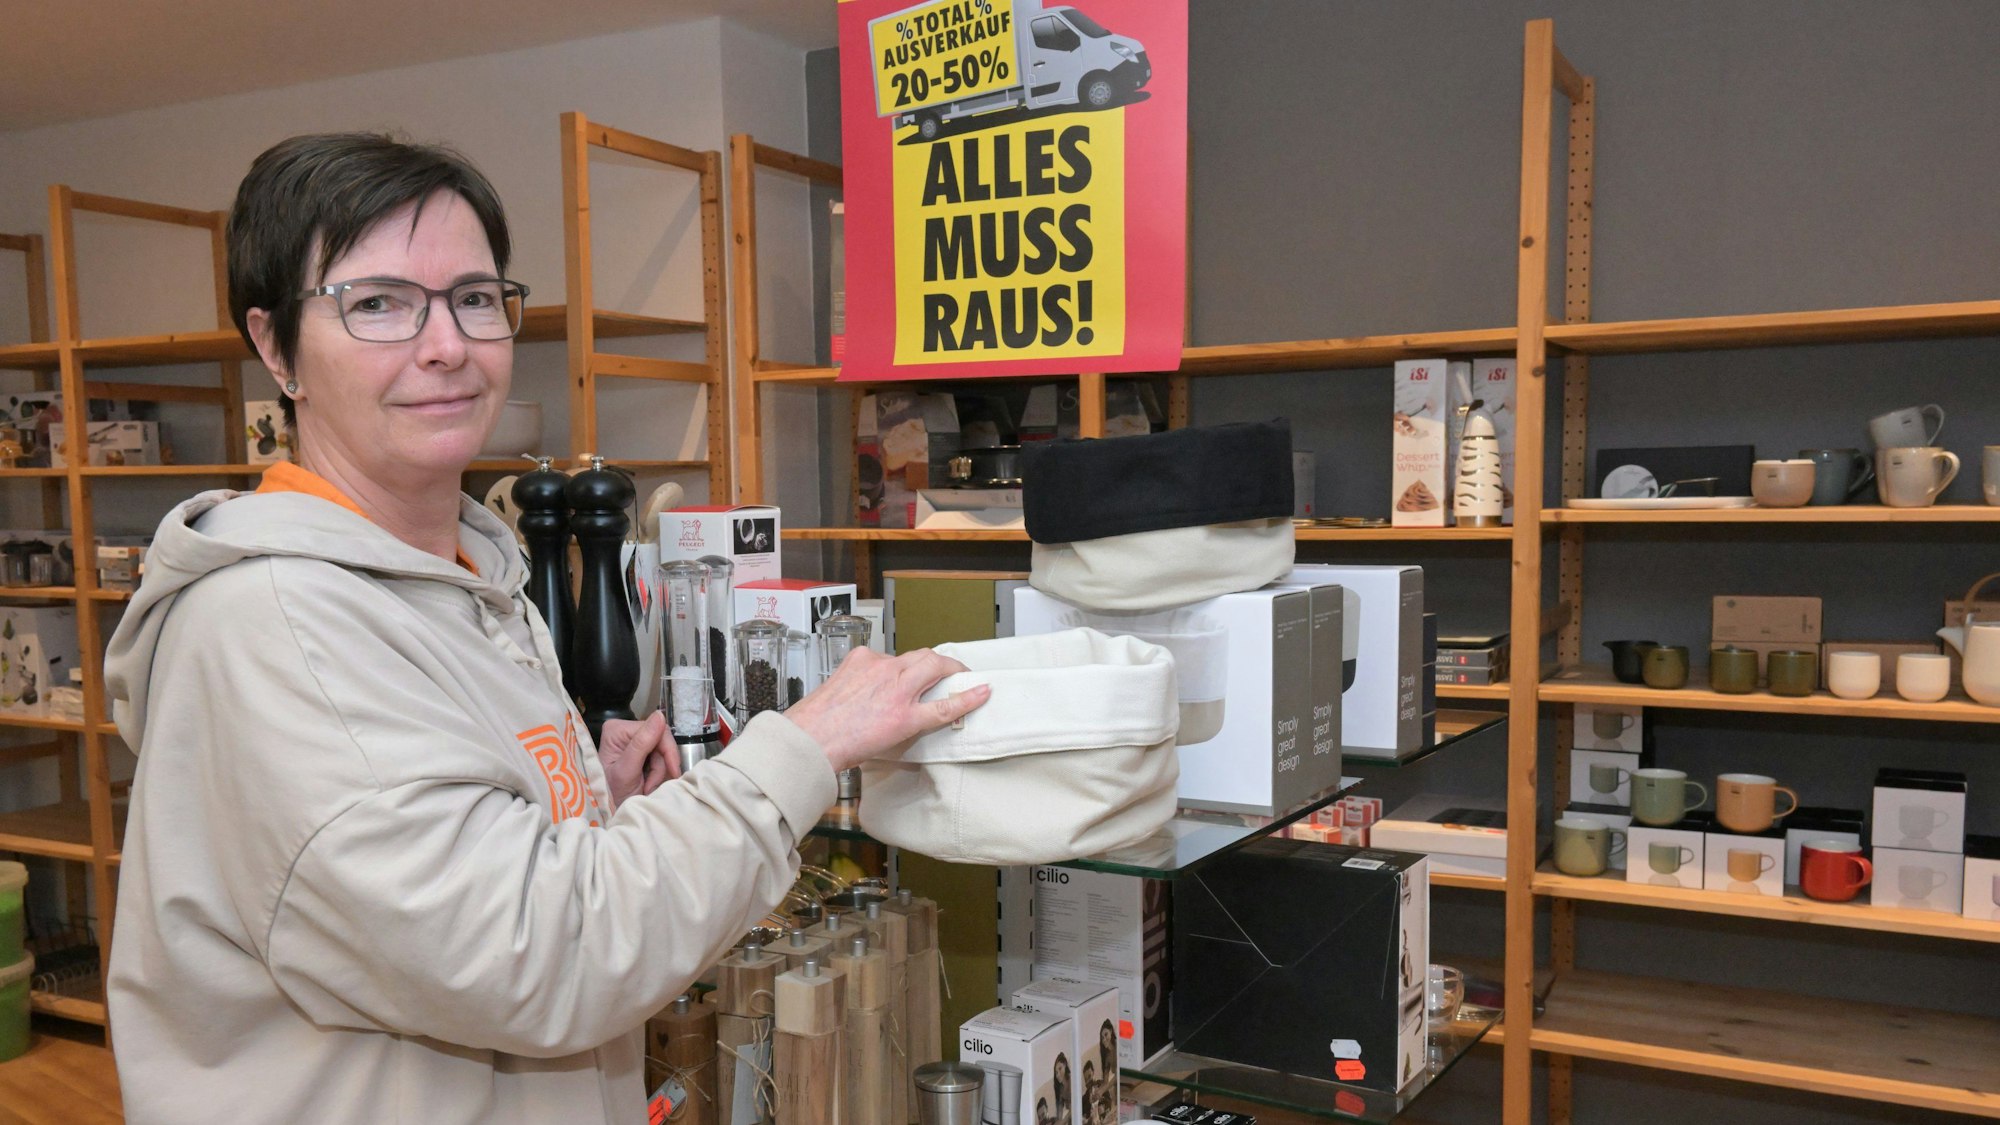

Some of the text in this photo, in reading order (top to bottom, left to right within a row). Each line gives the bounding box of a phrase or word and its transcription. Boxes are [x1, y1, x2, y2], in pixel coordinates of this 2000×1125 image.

[884, 11, 1010, 69] AUSVERKAUF
[891, 46, 1009, 107] 20-50%
[921, 125, 1093, 207] ALLES
[923, 203, 1093, 283] MUSS
[923, 280, 1094, 353] RAUS!
[1397, 452, 1439, 462] Dessert
[1401, 675, 1416, 690] Simply
[1401, 691, 1414, 707] great
[1313, 702, 1332, 720] Simply
[1401, 705, 1416, 720] design
[1277, 716, 1299, 736] Simply
[1313, 721, 1330, 741] great
[1277, 736, 1297, 757] great
[1313, 738, 1334, 756] design
[1278, 754, 1300, 773] design
[1036, 868, 1069, 884] cilio
[964, 1038, 993, 1055] cilio
